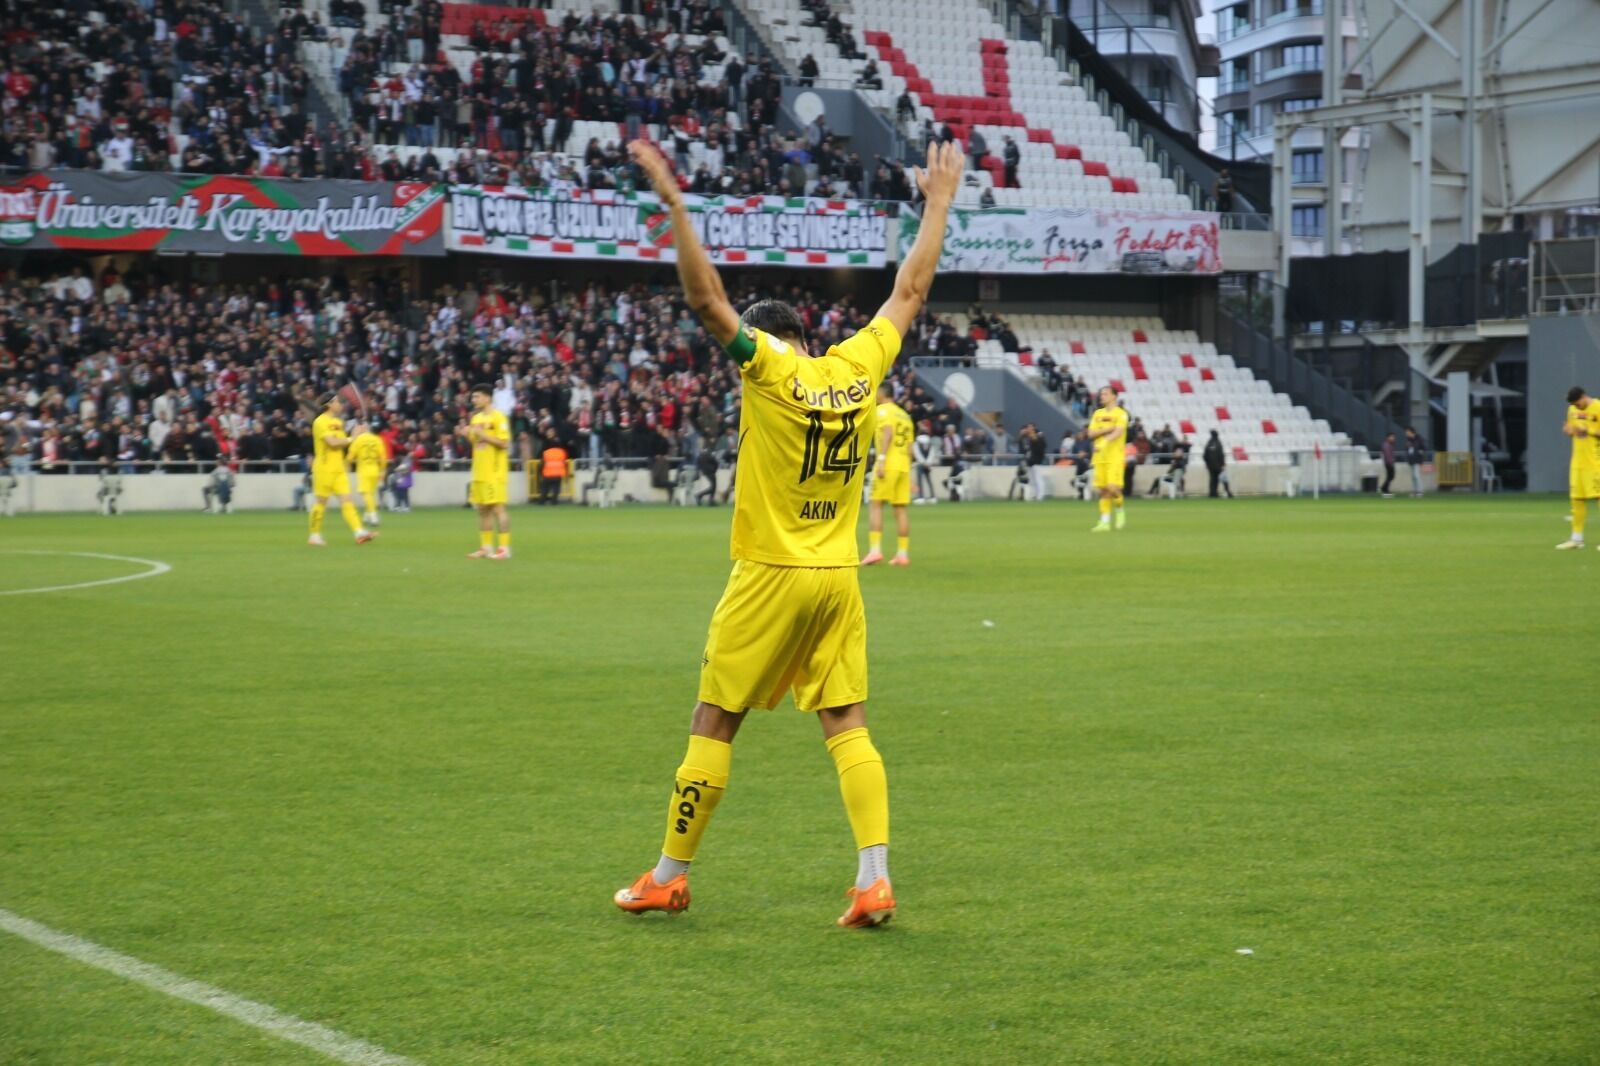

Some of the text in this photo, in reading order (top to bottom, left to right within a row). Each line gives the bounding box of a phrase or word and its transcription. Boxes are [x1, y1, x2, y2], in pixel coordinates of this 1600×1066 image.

[36, 182, 198, 230] Üniversiteli
[799, 408, 862, 486] 14
[799, 500, 837, 519] AKIN
